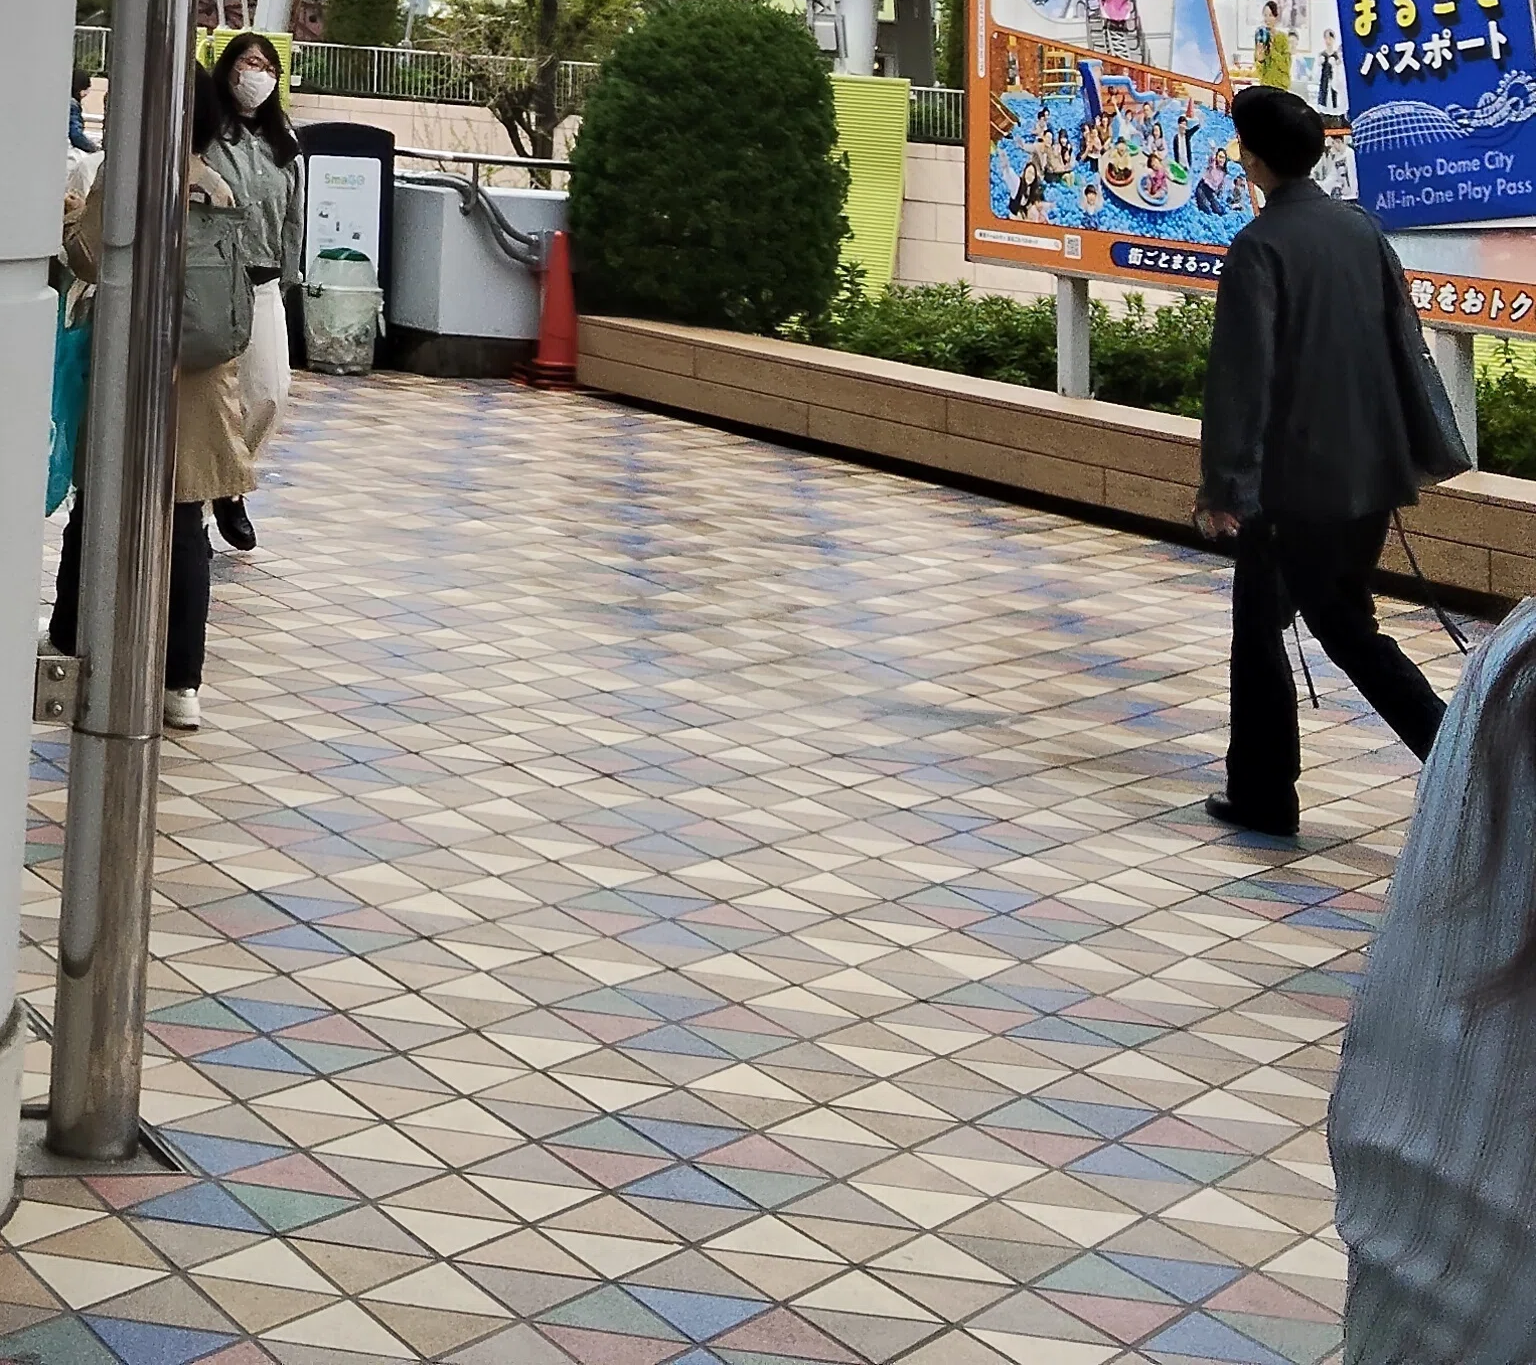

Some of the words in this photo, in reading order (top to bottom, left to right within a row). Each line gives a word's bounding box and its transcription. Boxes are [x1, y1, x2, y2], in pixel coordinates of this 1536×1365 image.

[1360, 20, 1508, 76] パスポート
[1387, 161, 1433, 184] Tokyo
[1436, 157, 1481, 176] Dome
[1484, 150, 1516, 173] City
[1375, 186, 1454, 211] All-in-One
[1458, 180, 1493, 203] Play
[1496, 178, 1533, 197] Pass
